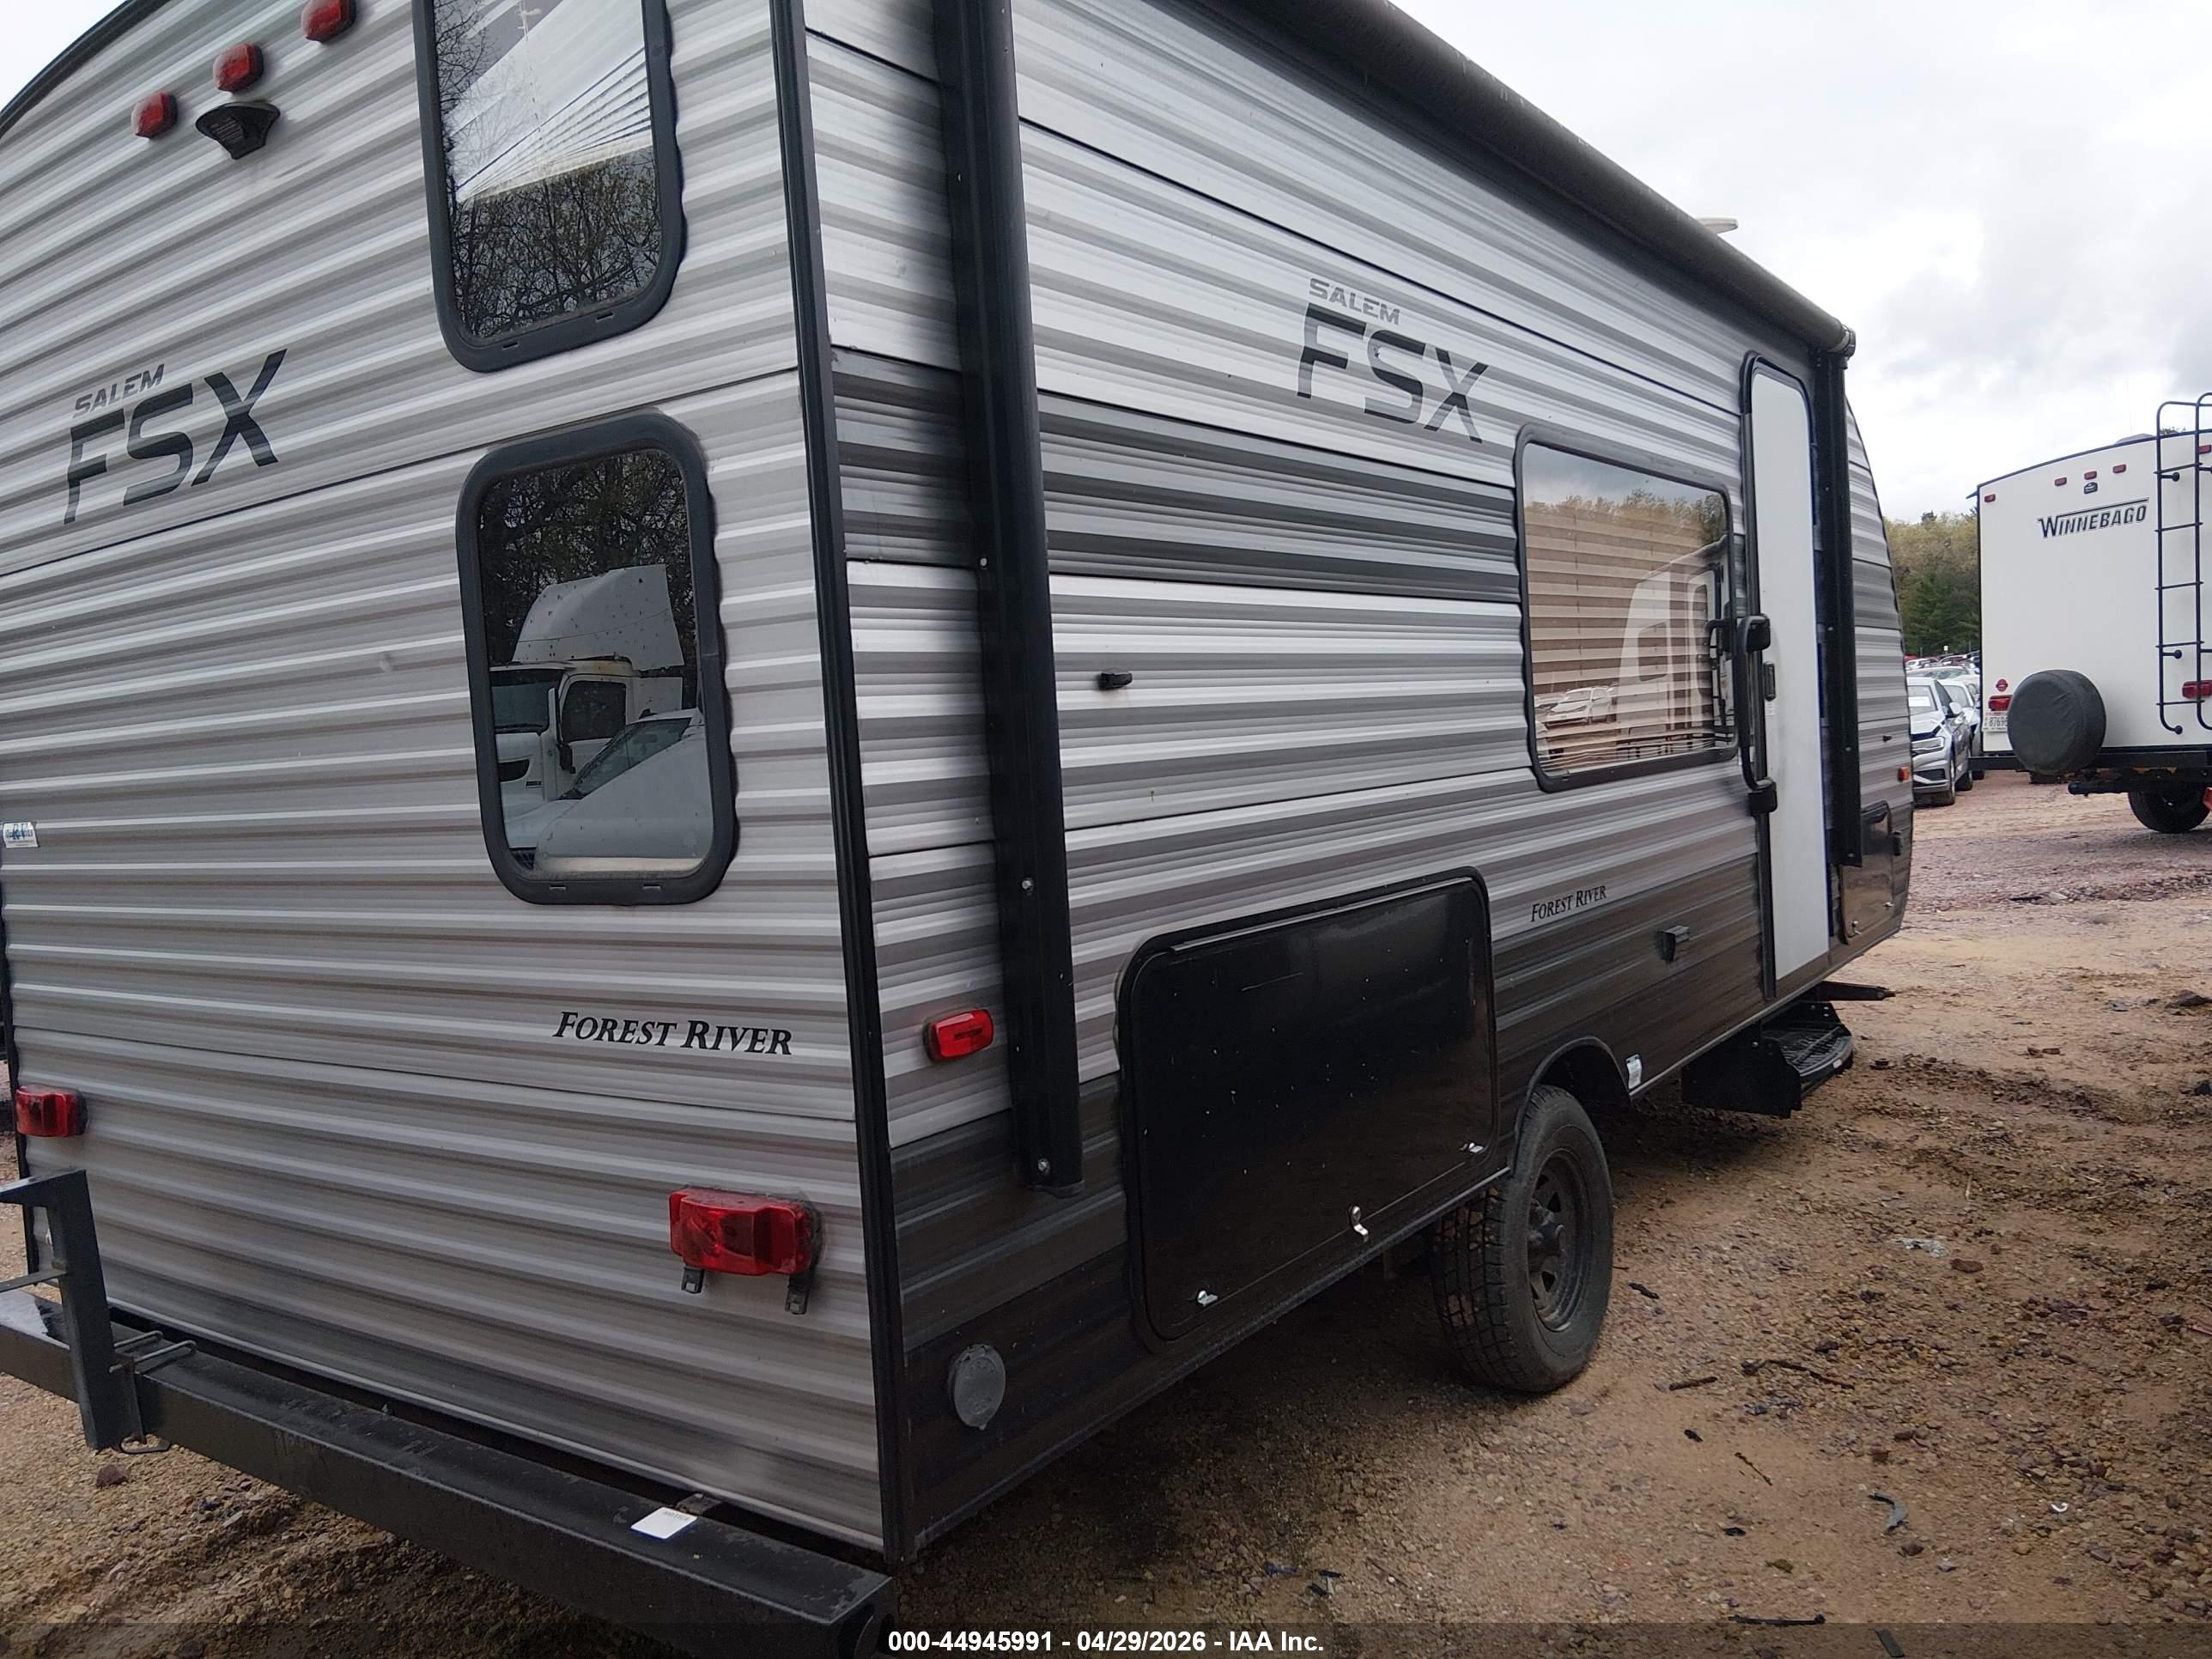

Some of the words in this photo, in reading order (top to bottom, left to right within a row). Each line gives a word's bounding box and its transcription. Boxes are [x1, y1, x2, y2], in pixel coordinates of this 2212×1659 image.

[1309, 277, 1400, 325] SALEM
[73, 363, 165, 418] SALEM
[1297, 302, 1489, 443] FSX
[64, 349, 288, 525] FSX
[2038, 500, 2148, 538] WINNEBAGO
[1530, 895, 1573, 922] FOREST
[1576, 885, 1607, 908] RIVER
[552, 1012, 678, 1046] FOREST
[680, 1019, 793, 1055] RIVER
